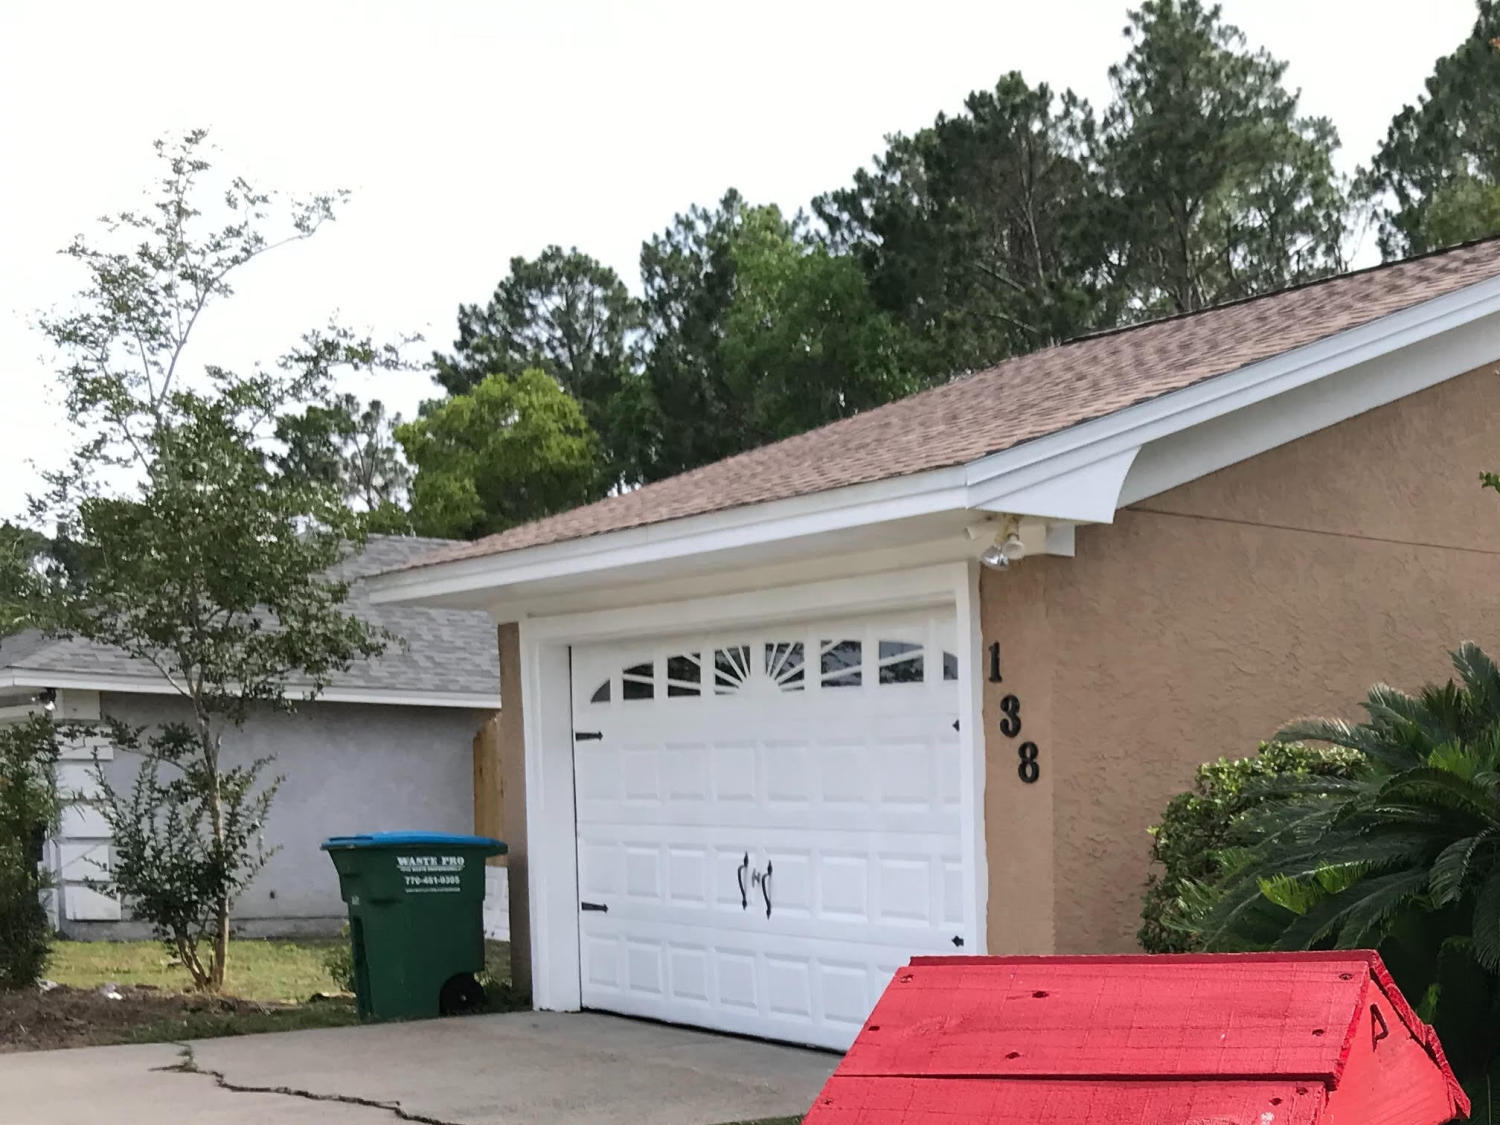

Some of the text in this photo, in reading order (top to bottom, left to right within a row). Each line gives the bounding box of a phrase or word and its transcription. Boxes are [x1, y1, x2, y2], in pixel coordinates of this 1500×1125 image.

[988, 641, 1040, 784] 138
[397, 856, 465, 866] WASTE PRO
